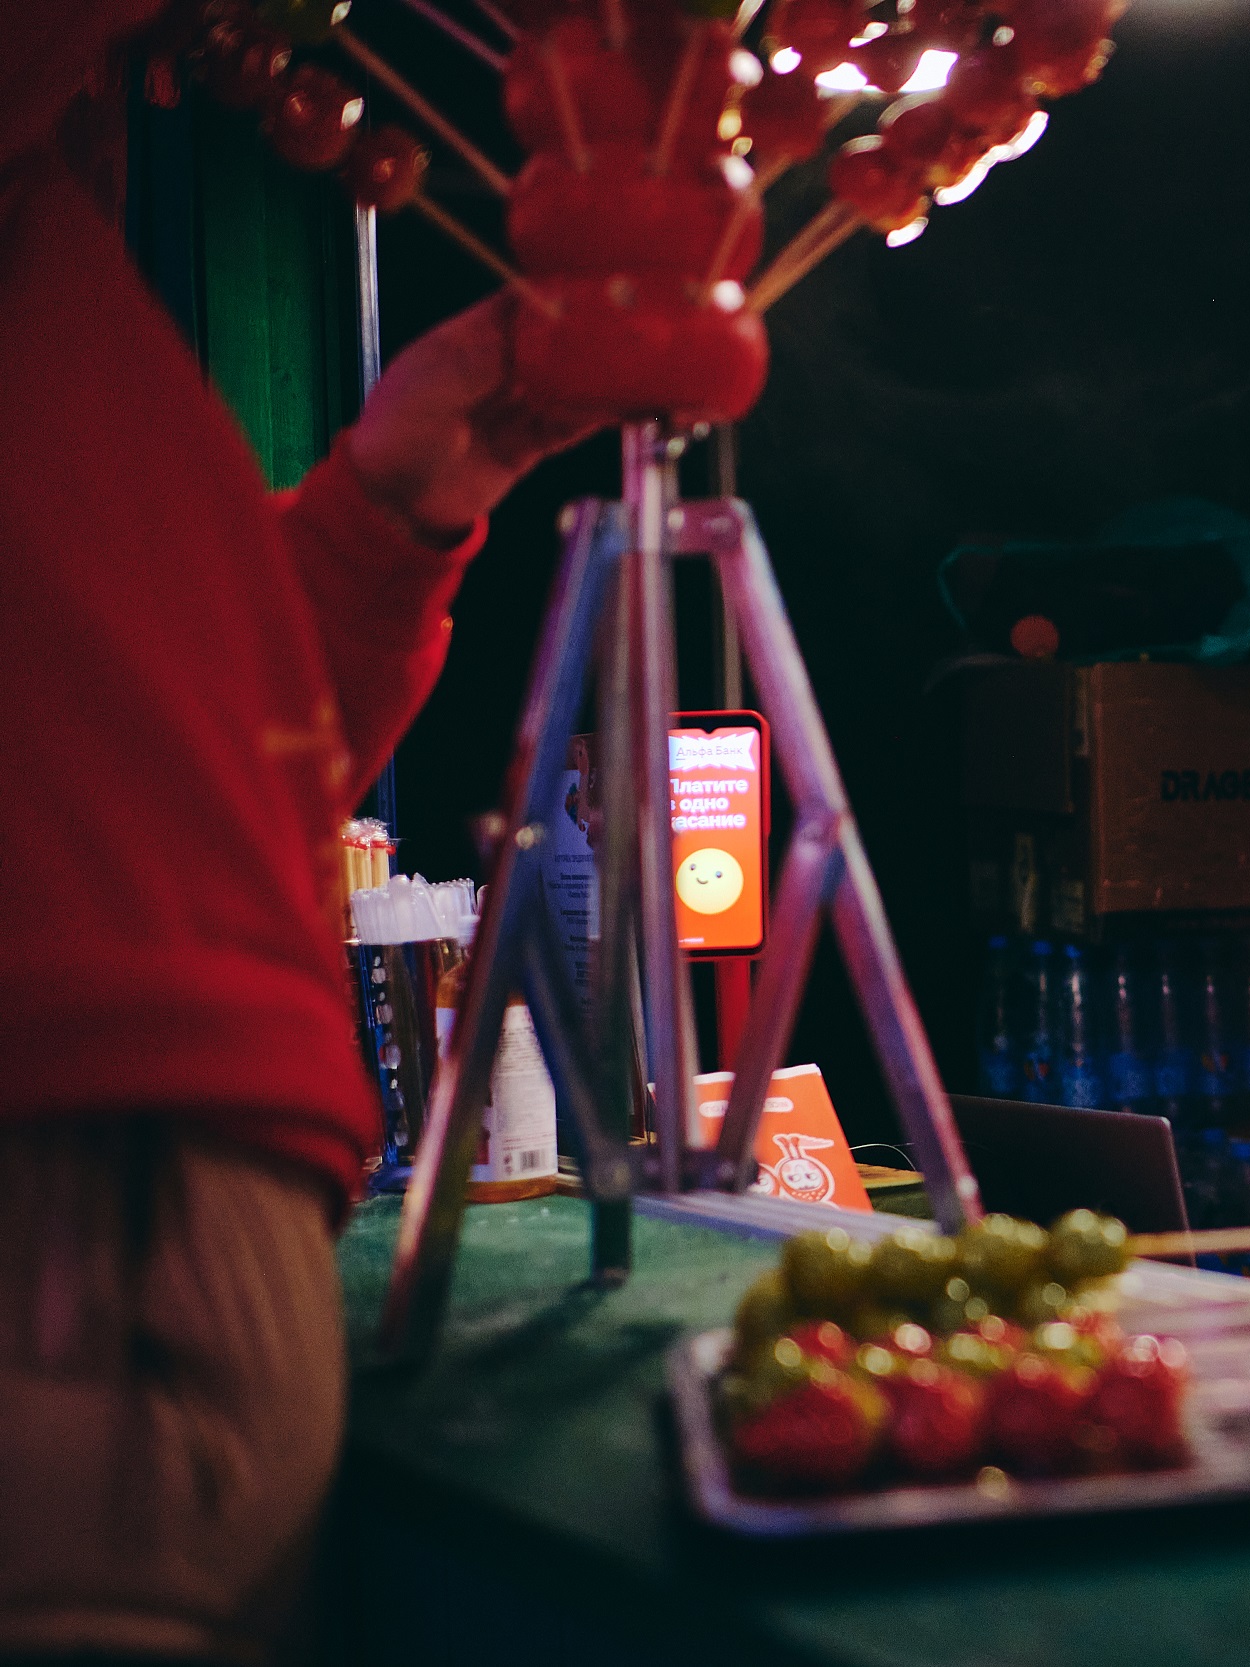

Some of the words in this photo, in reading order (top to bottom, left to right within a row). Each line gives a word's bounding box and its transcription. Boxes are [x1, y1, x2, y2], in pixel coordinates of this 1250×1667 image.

[676, 746, 713, 760] Альфа
[715, 745, 743, 756] Банк
[679, 797, 731, 813] одно
